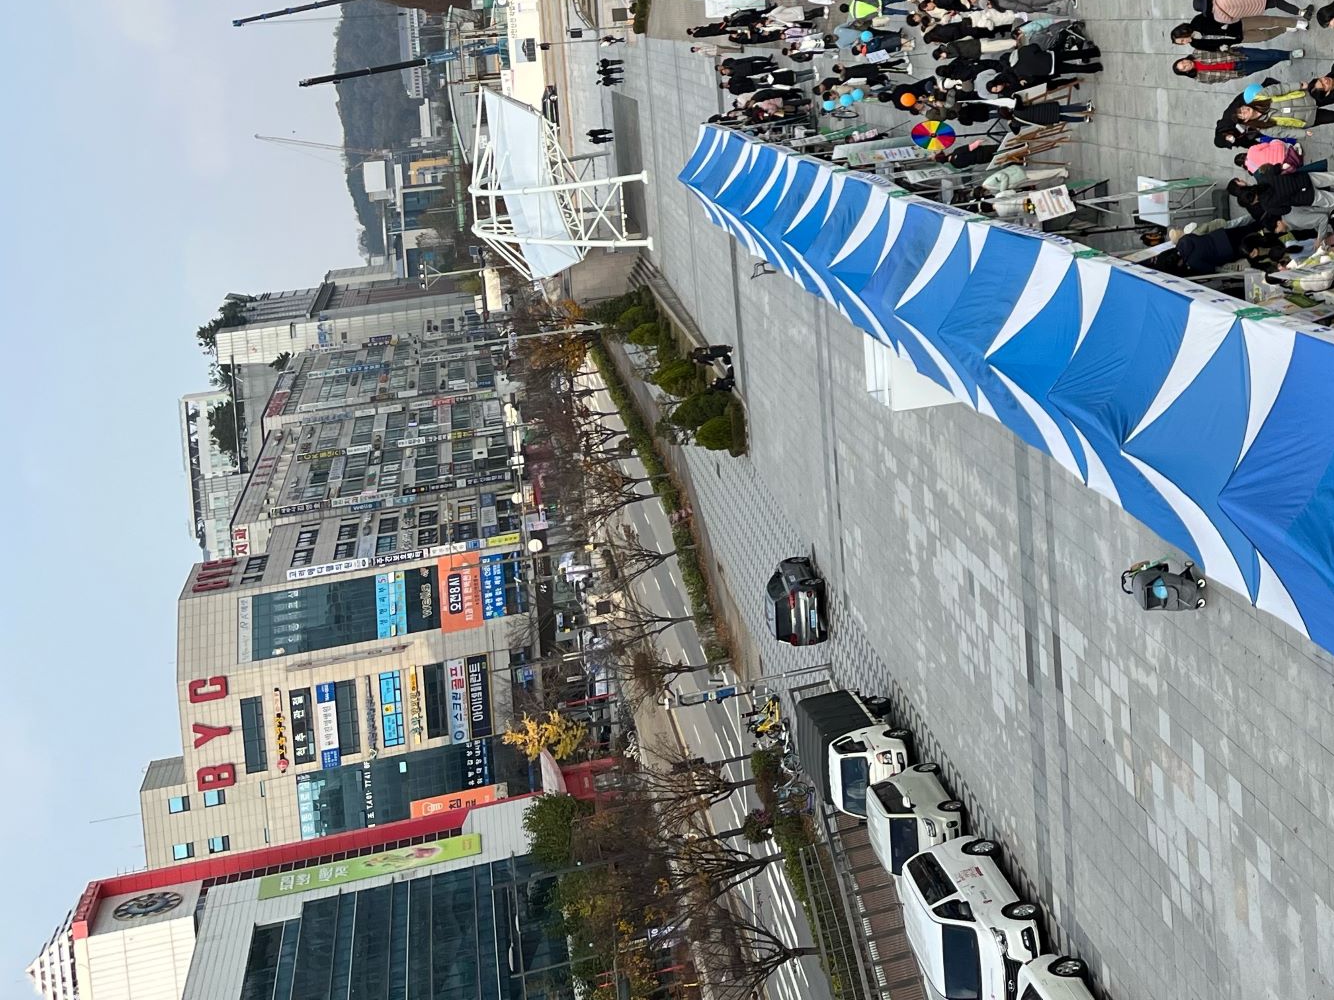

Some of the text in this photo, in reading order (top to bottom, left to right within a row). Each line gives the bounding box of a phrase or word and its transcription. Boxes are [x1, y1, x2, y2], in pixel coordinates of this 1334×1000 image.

[420, 583, 433, 618] wells
[448, 576, 462, 611] 오전8시
[188, 675, 237, 792] BYC
[291, 695, 307, 757] 척추 관절
